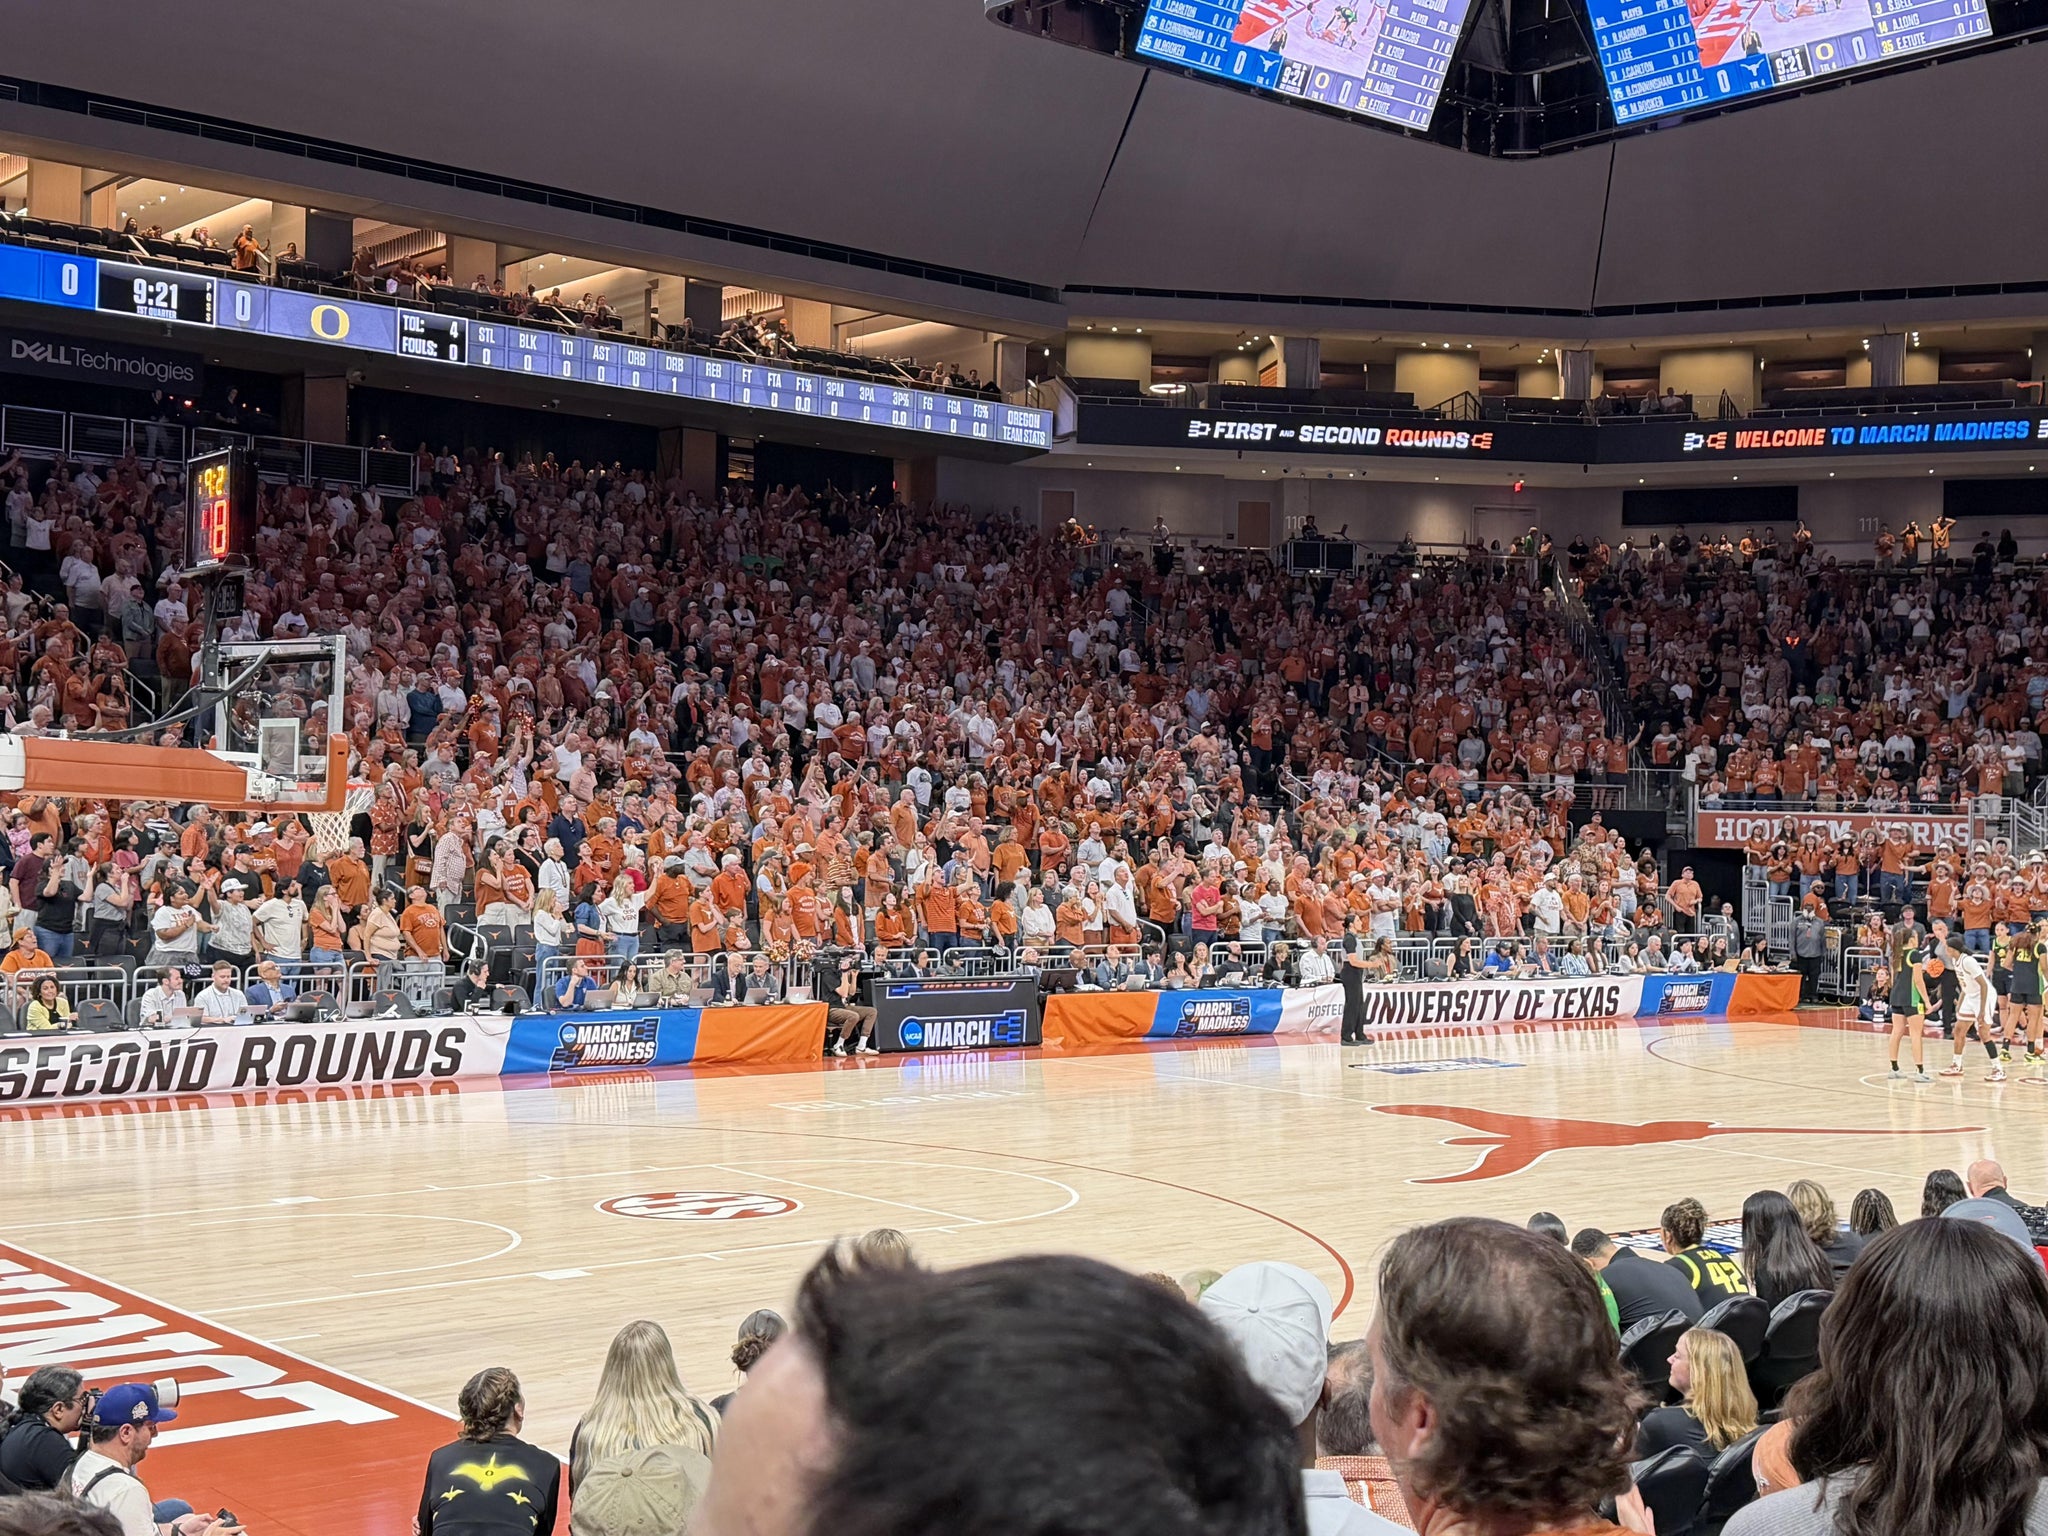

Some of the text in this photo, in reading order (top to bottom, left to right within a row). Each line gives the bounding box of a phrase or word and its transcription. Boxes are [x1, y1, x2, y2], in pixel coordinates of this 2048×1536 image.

[1874, 2, 1883, 14] 3
[1384, 24, 1390, 35] 1
[1877, 20, 1889, 34] 14
[1892, 13, 1920, 31] A.LONG
[1377, 42, 1385, 54] 2
[1851, 36, 1867, 61] 0
[1881, 39, 1894, 53] 35
[1895, 32, 1927, 50] E.ETUTE
[1233, 50, 1248, 75] 0
[1621, 60, 1655, 80] J.CARLTON
[1775, 52, 1803, 77] 9:21
[1281, 66, 1305, 87] 9:21
[1716, 69, 1731, 93] 0
[1338, 80, 1353, 104] 0
[61, 263, 79, 296] 0
[133, 278, 179, 309] 9:21
[148, 307, 178, 320] QUARTER
[235, 289, 251, 322] 0
[310, 304, 350, 340] O
[402, 314, 459, 339] TOL: 4
[478, 326, 495, 344] STL
[519, 333, 537, 351] BLK
[402, 336, 458, 361] FOULS: 0
[561, 339, 574, 356] TO
[592, 344, 610, 362] AST
[11, 338, 195, 383] DELL Technologies
[482, 348, 491, 365] 0
[523, 355, 532, 372] 0
[627, 349, 646, 366] ORB
[666, 355, 684, 372] DRB
[562, 360, 571, 377] 0
[597, 365, 605, 382] 0
[705, 361, 722, 378] REB
[742, 368, 753, 384] FT
[632, 371, 640, 388] 0
[671, 377, 678, 393] 1
[767, 372, 782, 389] FTA
[795, 376, 812, 393] FT%
[709, 382, 716, 399] 1
[743, 388, 750, 404] 0
[826, 381, 844, 399] 3PM
[859, 386, 875, 403] 3PA
[892, 390, 910, 407] 3P%
[771, 392, 778, 408] 0
[795, 396, 811, 413] 0.0
[923, 394, 933, 411] FG
[947, 399, 962, 415] FGA
[830, 401, 838, 417] 0
[863, 405, 870, 421] 0
[892, 409, 907, 426] 0.0
[973, 403, 989, 419] FG%
[924, 414, 931, 430] 0
[950, 418, 957, 434] 0
[1007, 409, 1040, 430] OREGON
[972, 421, 987, 439] 0.0
[1002, 425, 1046, 446] TEAM STATS
[1213, 421, 1471, 449] FIRST AND SECOND ROUNDS
[1735, 420, 2030, 449] WELCOME TO MARCH MADNESS
[1672, 984, 1699, 997] MARCH
[1194, 1002, 1232, 1017] MARCH
[1308, 1003, 1344, 1018] HOSTED
[1363, 985, 1620, 1025] UNIVERSITY OF TEXAS
[1673, 995, 1709, 1009] MADNESS
[1197, 1015, 1249, 1031] MADNESS
[577, 1024, 632, 1044] MARCH
[923, 1020, 991, 1048] MARCH
[580, 1041, 656, 1061] MADNESS
[0, 1026, 466, 1100] SECOND ROUNDS
[1705, 1261, 1749, 1294] 42
